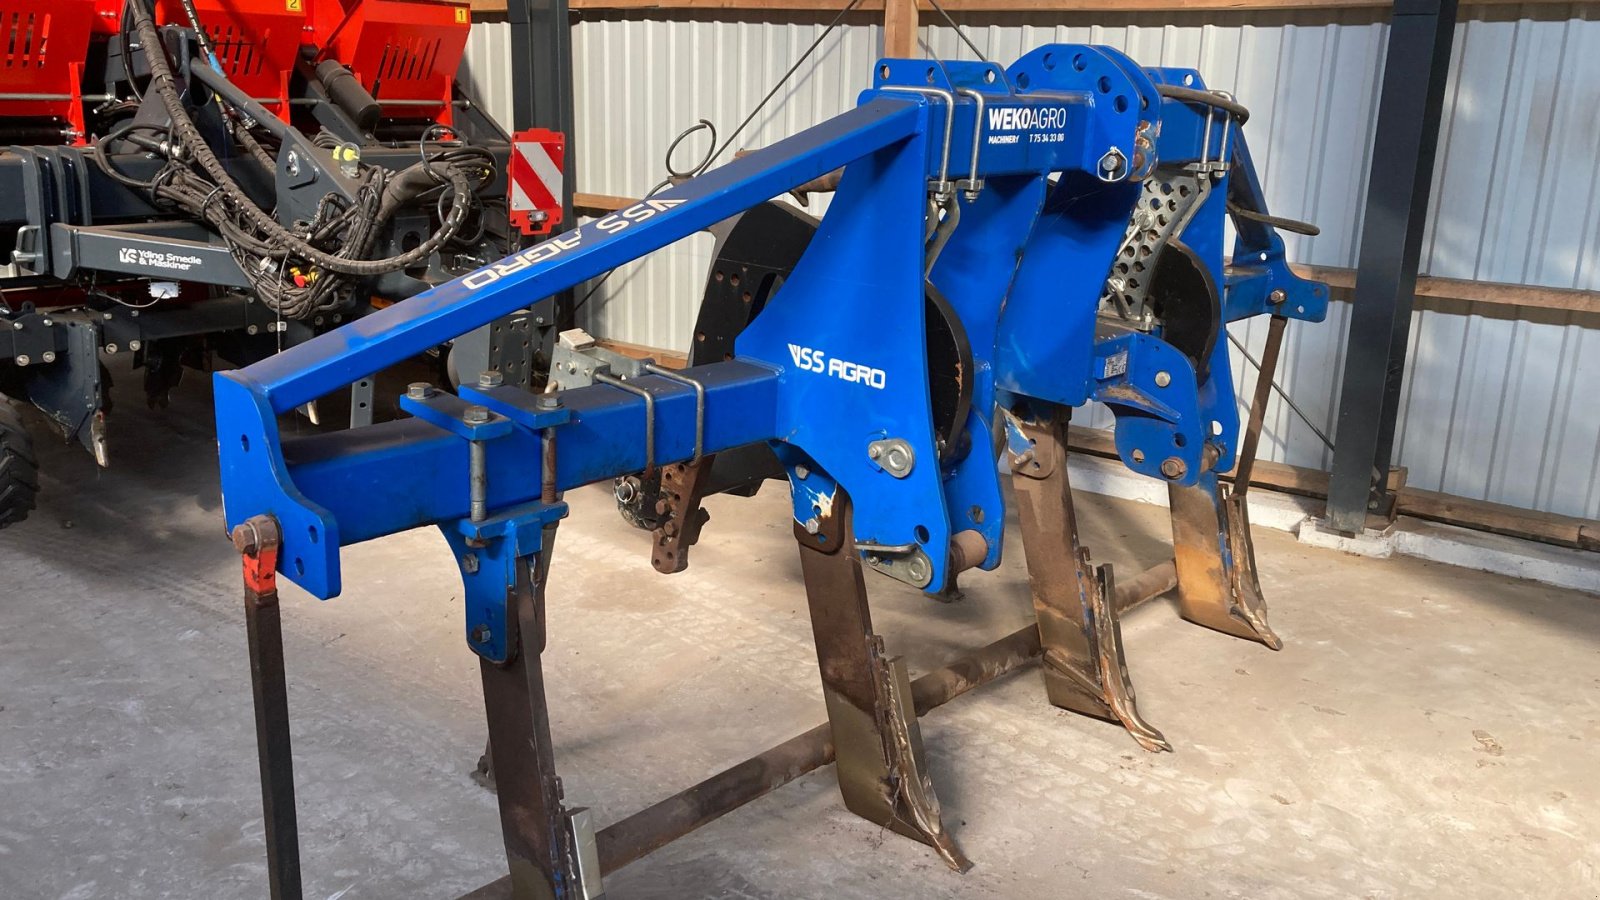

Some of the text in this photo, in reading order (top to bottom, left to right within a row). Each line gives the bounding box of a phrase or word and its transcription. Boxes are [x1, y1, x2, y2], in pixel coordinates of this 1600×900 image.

[290, 0, 297, 8] 2
[458, 10, 464, 21] 1
[988, 134, 1020, 144] MACHINERY
[1034, 133, 1041, 143] 75
[1049, 133, 1057, 143] 33
[462, 199, 688, 290] VSS AGRO
[138, 250, 202, 264] Yding Smedie
[138, 258, 191, 270] & Maskiner
[787, 343, 886, 390] VSS AGRO
